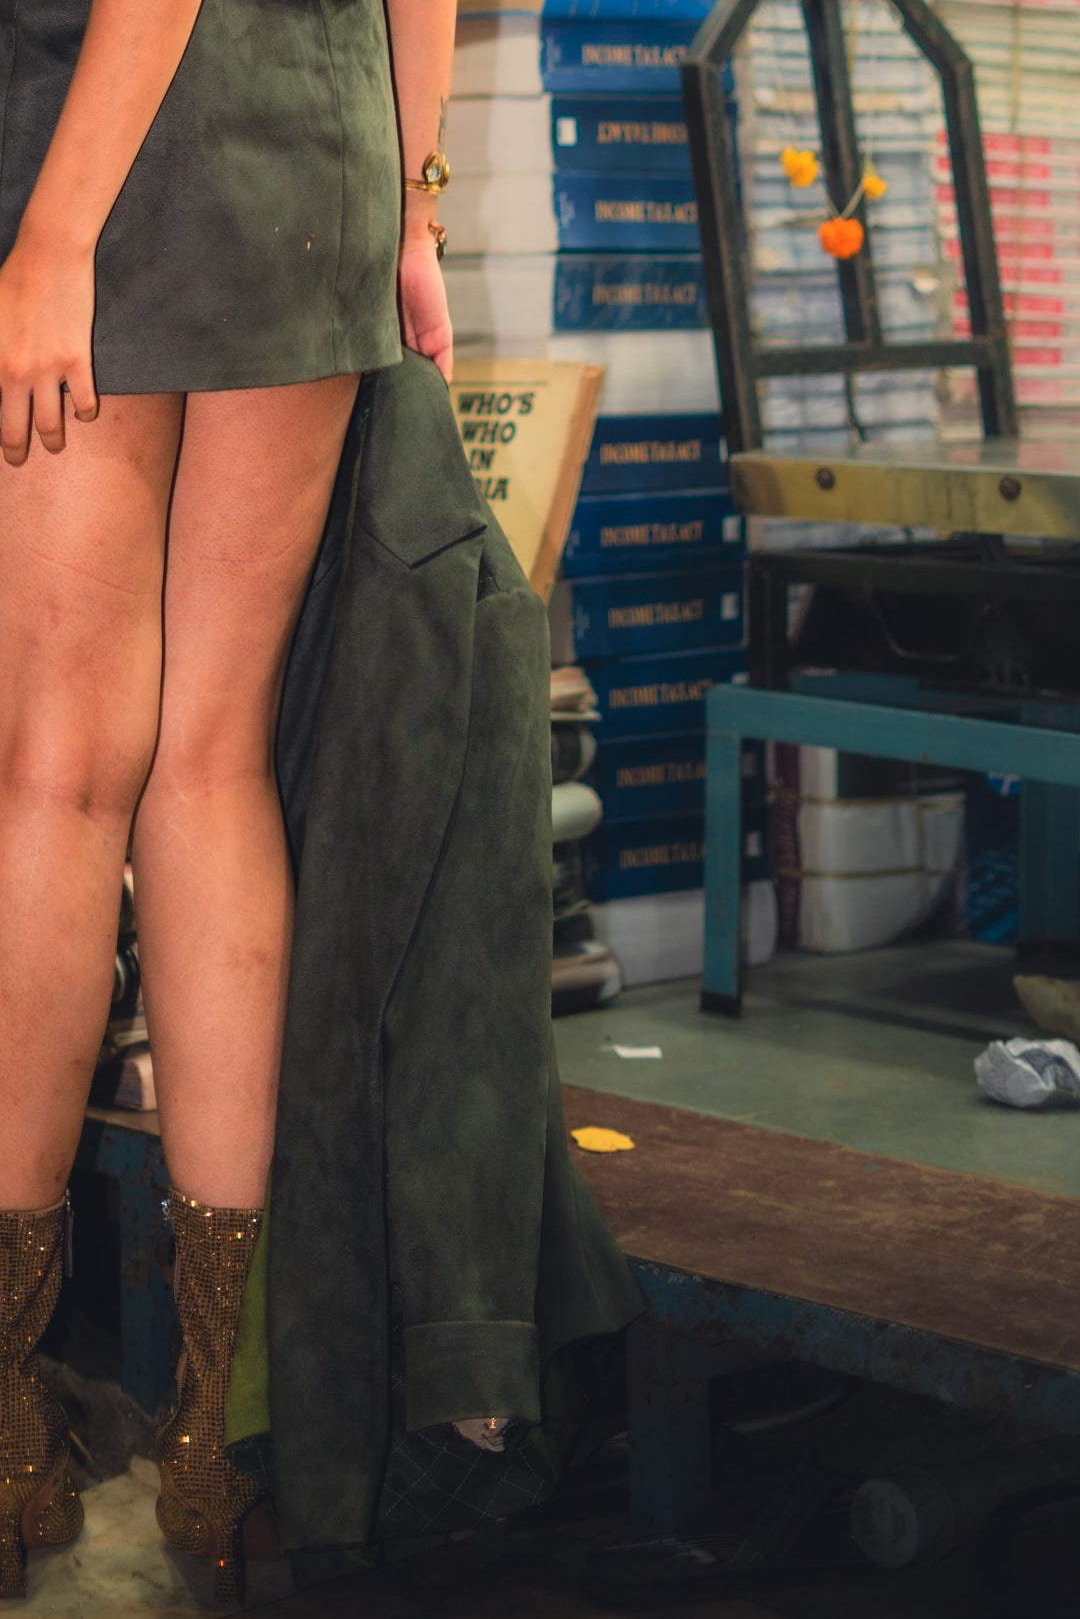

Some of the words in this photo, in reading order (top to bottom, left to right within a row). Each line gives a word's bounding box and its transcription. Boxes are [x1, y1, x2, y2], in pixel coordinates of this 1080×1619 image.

[595, 200, 645, 222] INCOME
[458, 391, 535, 415] WHO'S
[462, 421, 517, 444] WHO
[469, 448, 495, 472] IN
[600, 442, 649, 465] INCOME
[600, 524, 650, 548] INCOME
